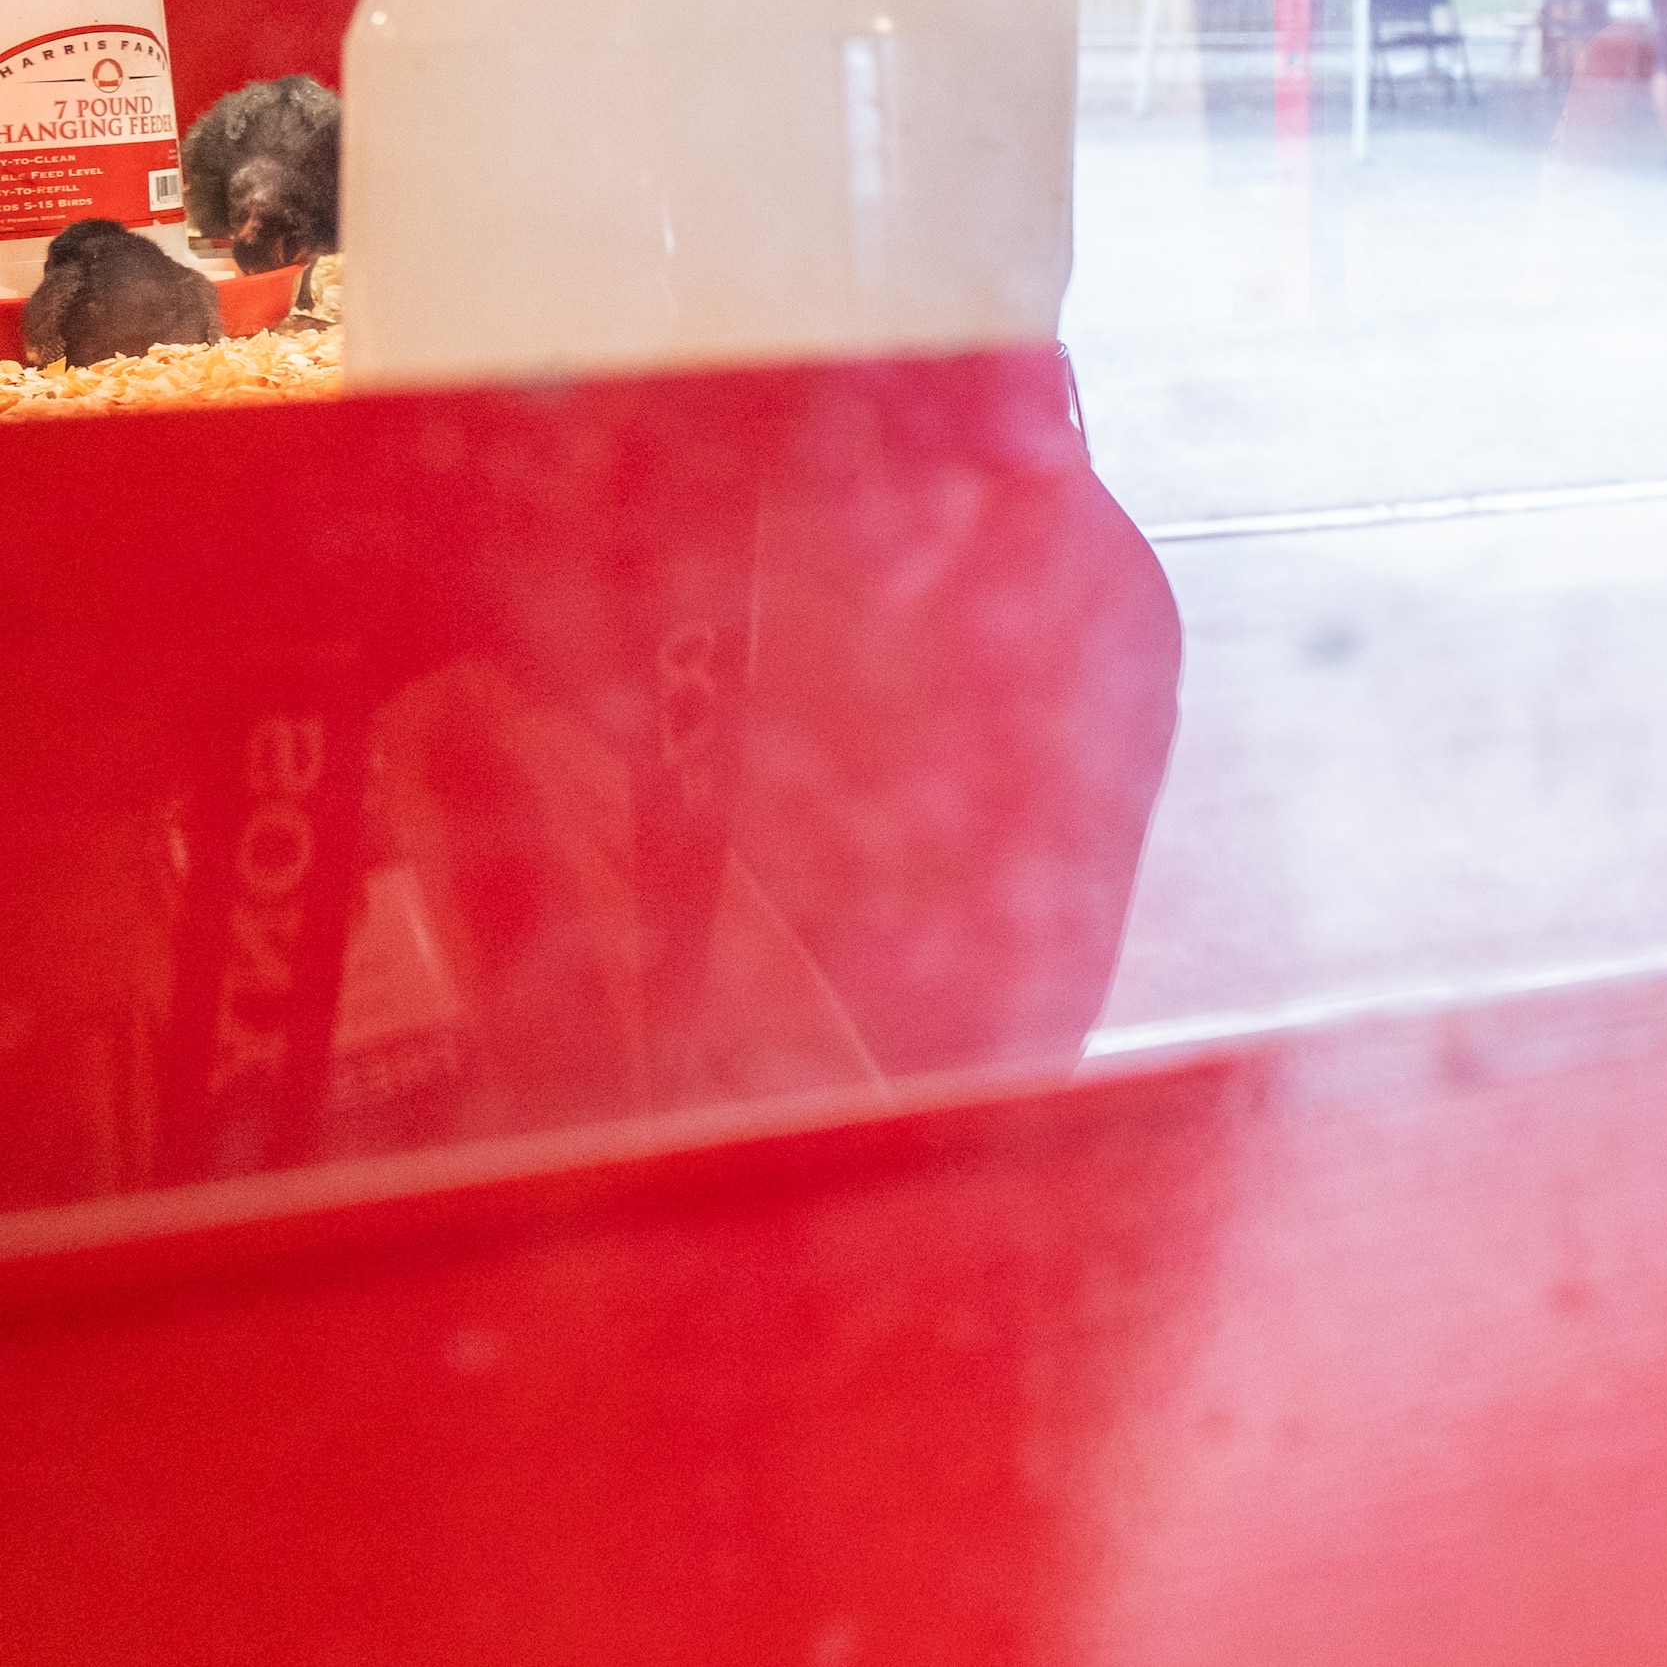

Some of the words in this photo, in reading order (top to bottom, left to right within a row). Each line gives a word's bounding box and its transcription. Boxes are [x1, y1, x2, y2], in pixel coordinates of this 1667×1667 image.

[0, 40, 107, 79] HARRIS
[54, 100, 68, 120] 7
[76, 96, 153, 119] POUND
[129, 114, 174, 136] FEEDER
[24, 200, 54, 211] 5-15
